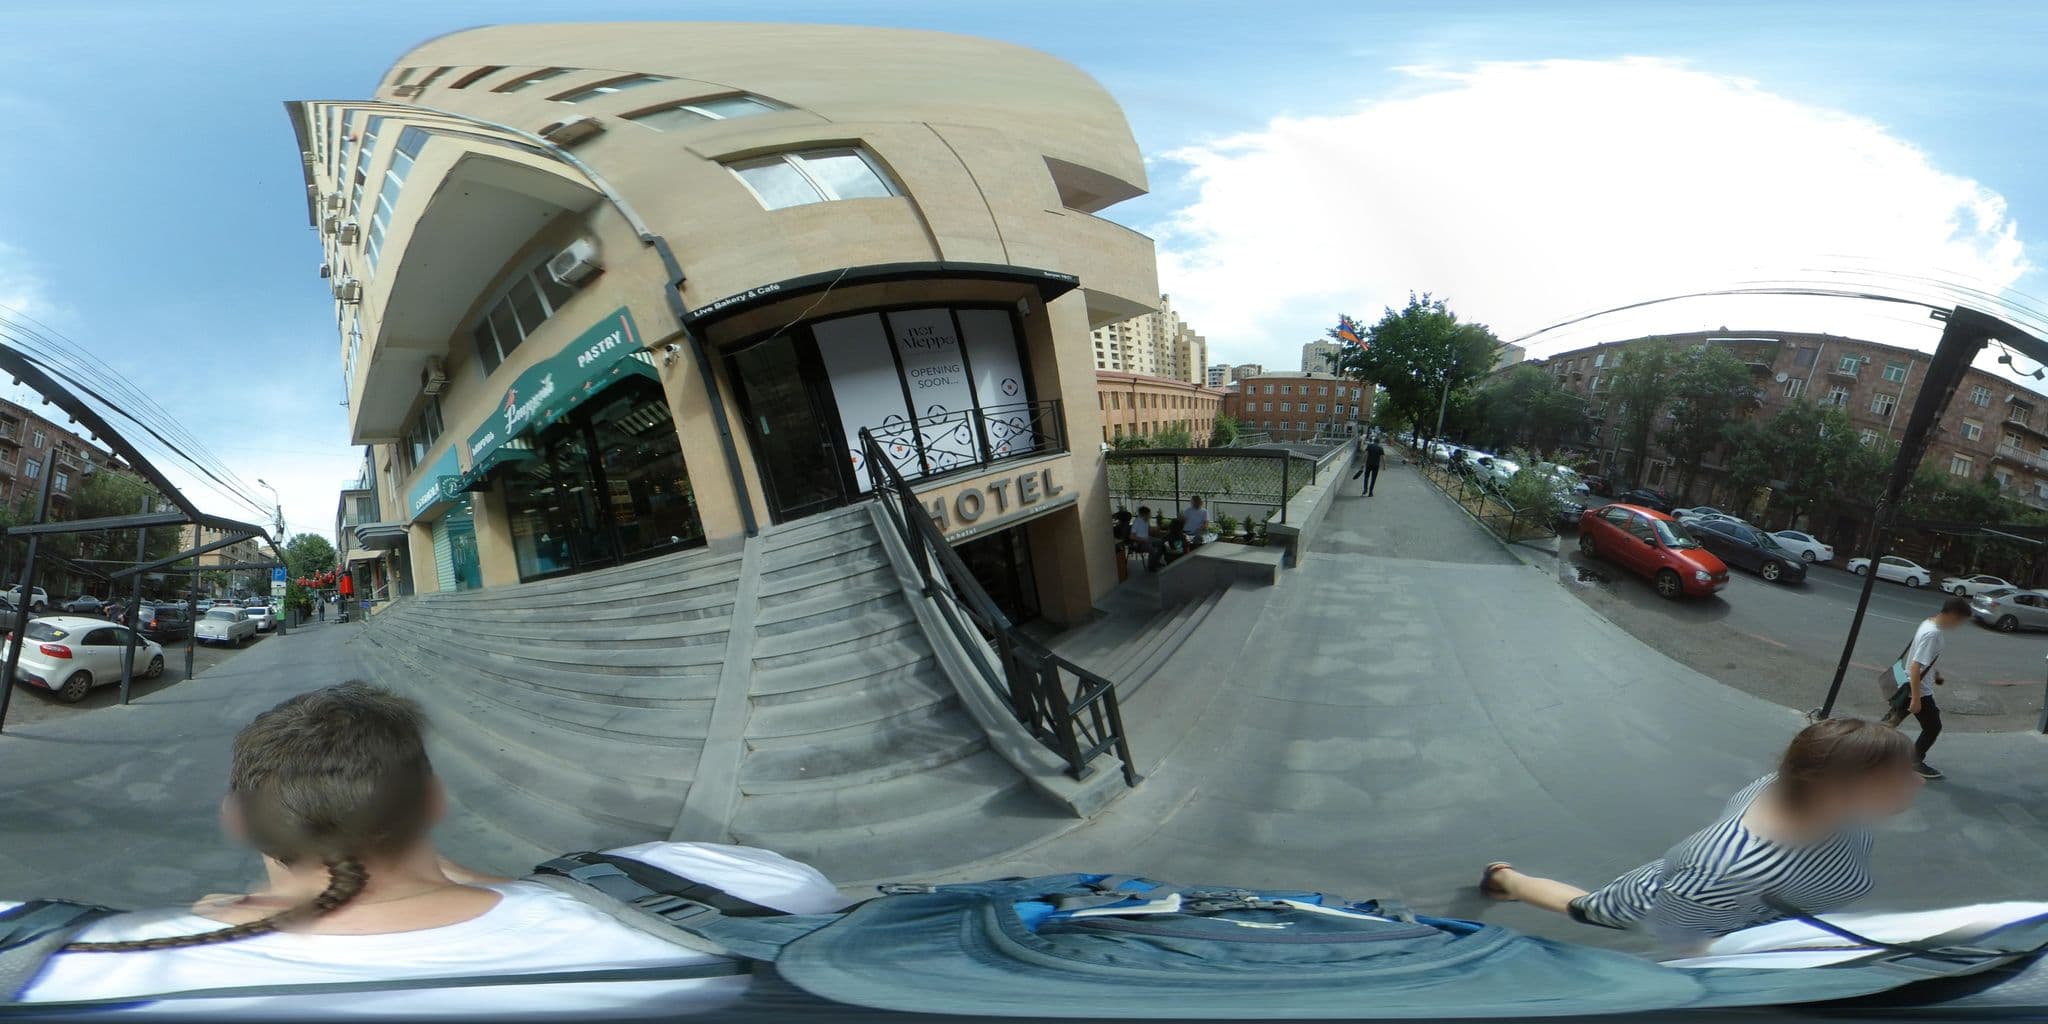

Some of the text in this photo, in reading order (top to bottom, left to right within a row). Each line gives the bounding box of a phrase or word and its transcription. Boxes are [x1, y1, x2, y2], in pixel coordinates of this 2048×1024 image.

[693, 284, 780, 317] Live Bakery & Café
[577, 330, 621, 368] PASTRY
[911, 364, 960, 378] OPENING
[922, 468, 1063, 530] HOTEL
